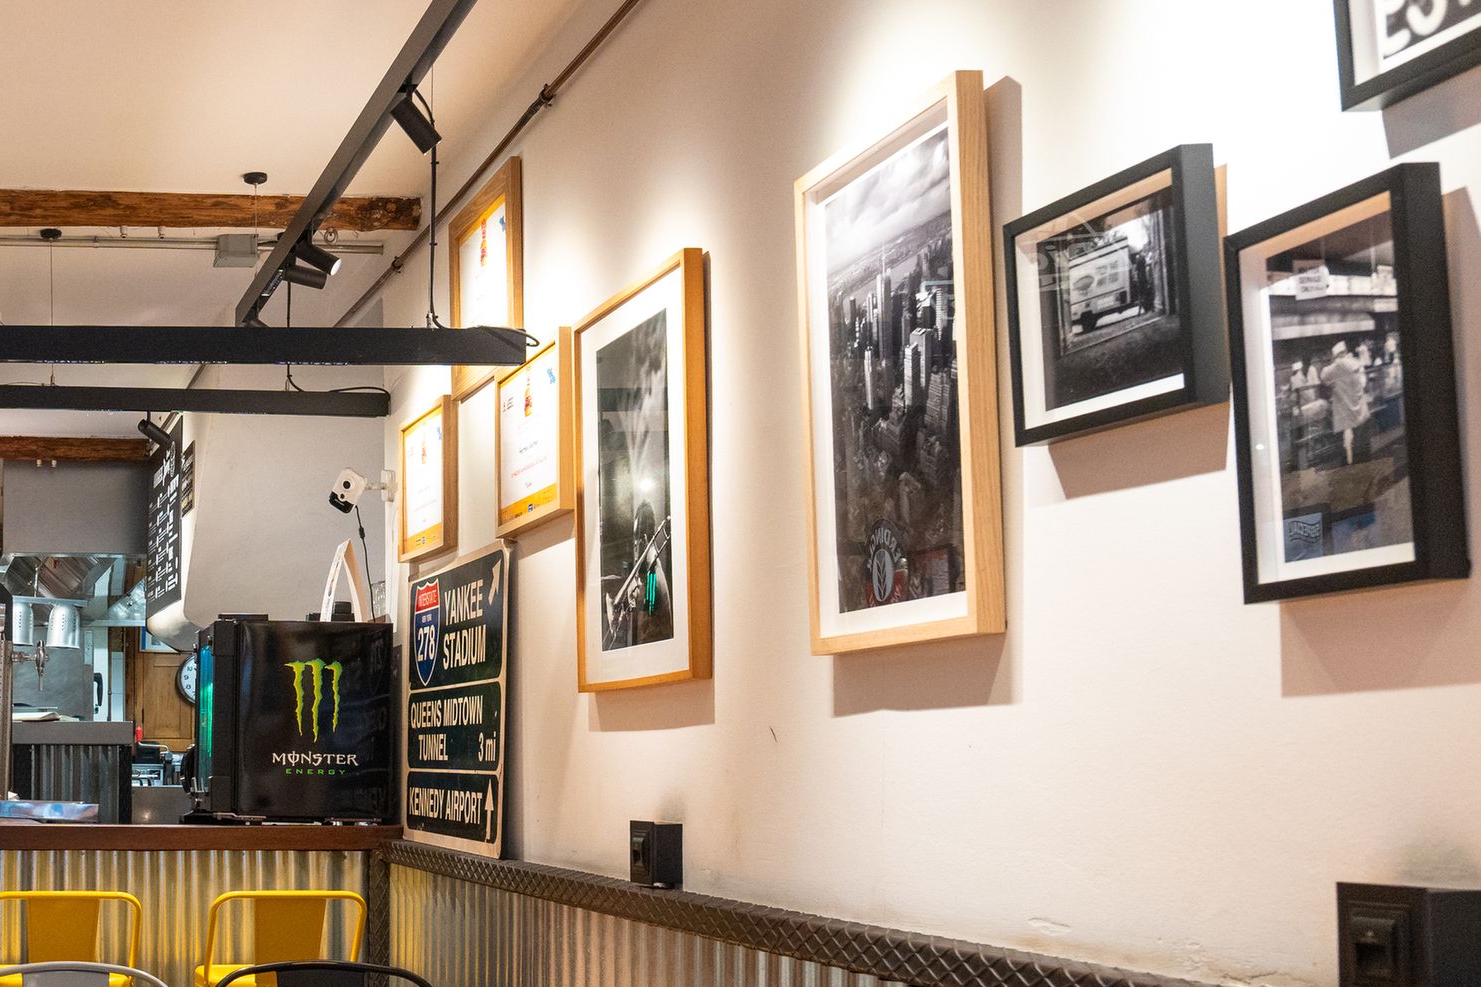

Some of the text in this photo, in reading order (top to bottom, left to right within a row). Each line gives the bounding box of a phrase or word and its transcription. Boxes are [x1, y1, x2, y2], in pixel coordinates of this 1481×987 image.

[443, 578, 484, 627] YANKEE
[417, 624, 436, 662] 278
[442, 624, 487, 670] STADIUM
[410, 695, 483, 729] QUEENS MIDTOWN
[272, 751, 359, 766] MONSTER
[418, 731, 496, 762] TUNNEL 3 mi
[409, 786, 483, 826] KENNEDY AIRPORT
